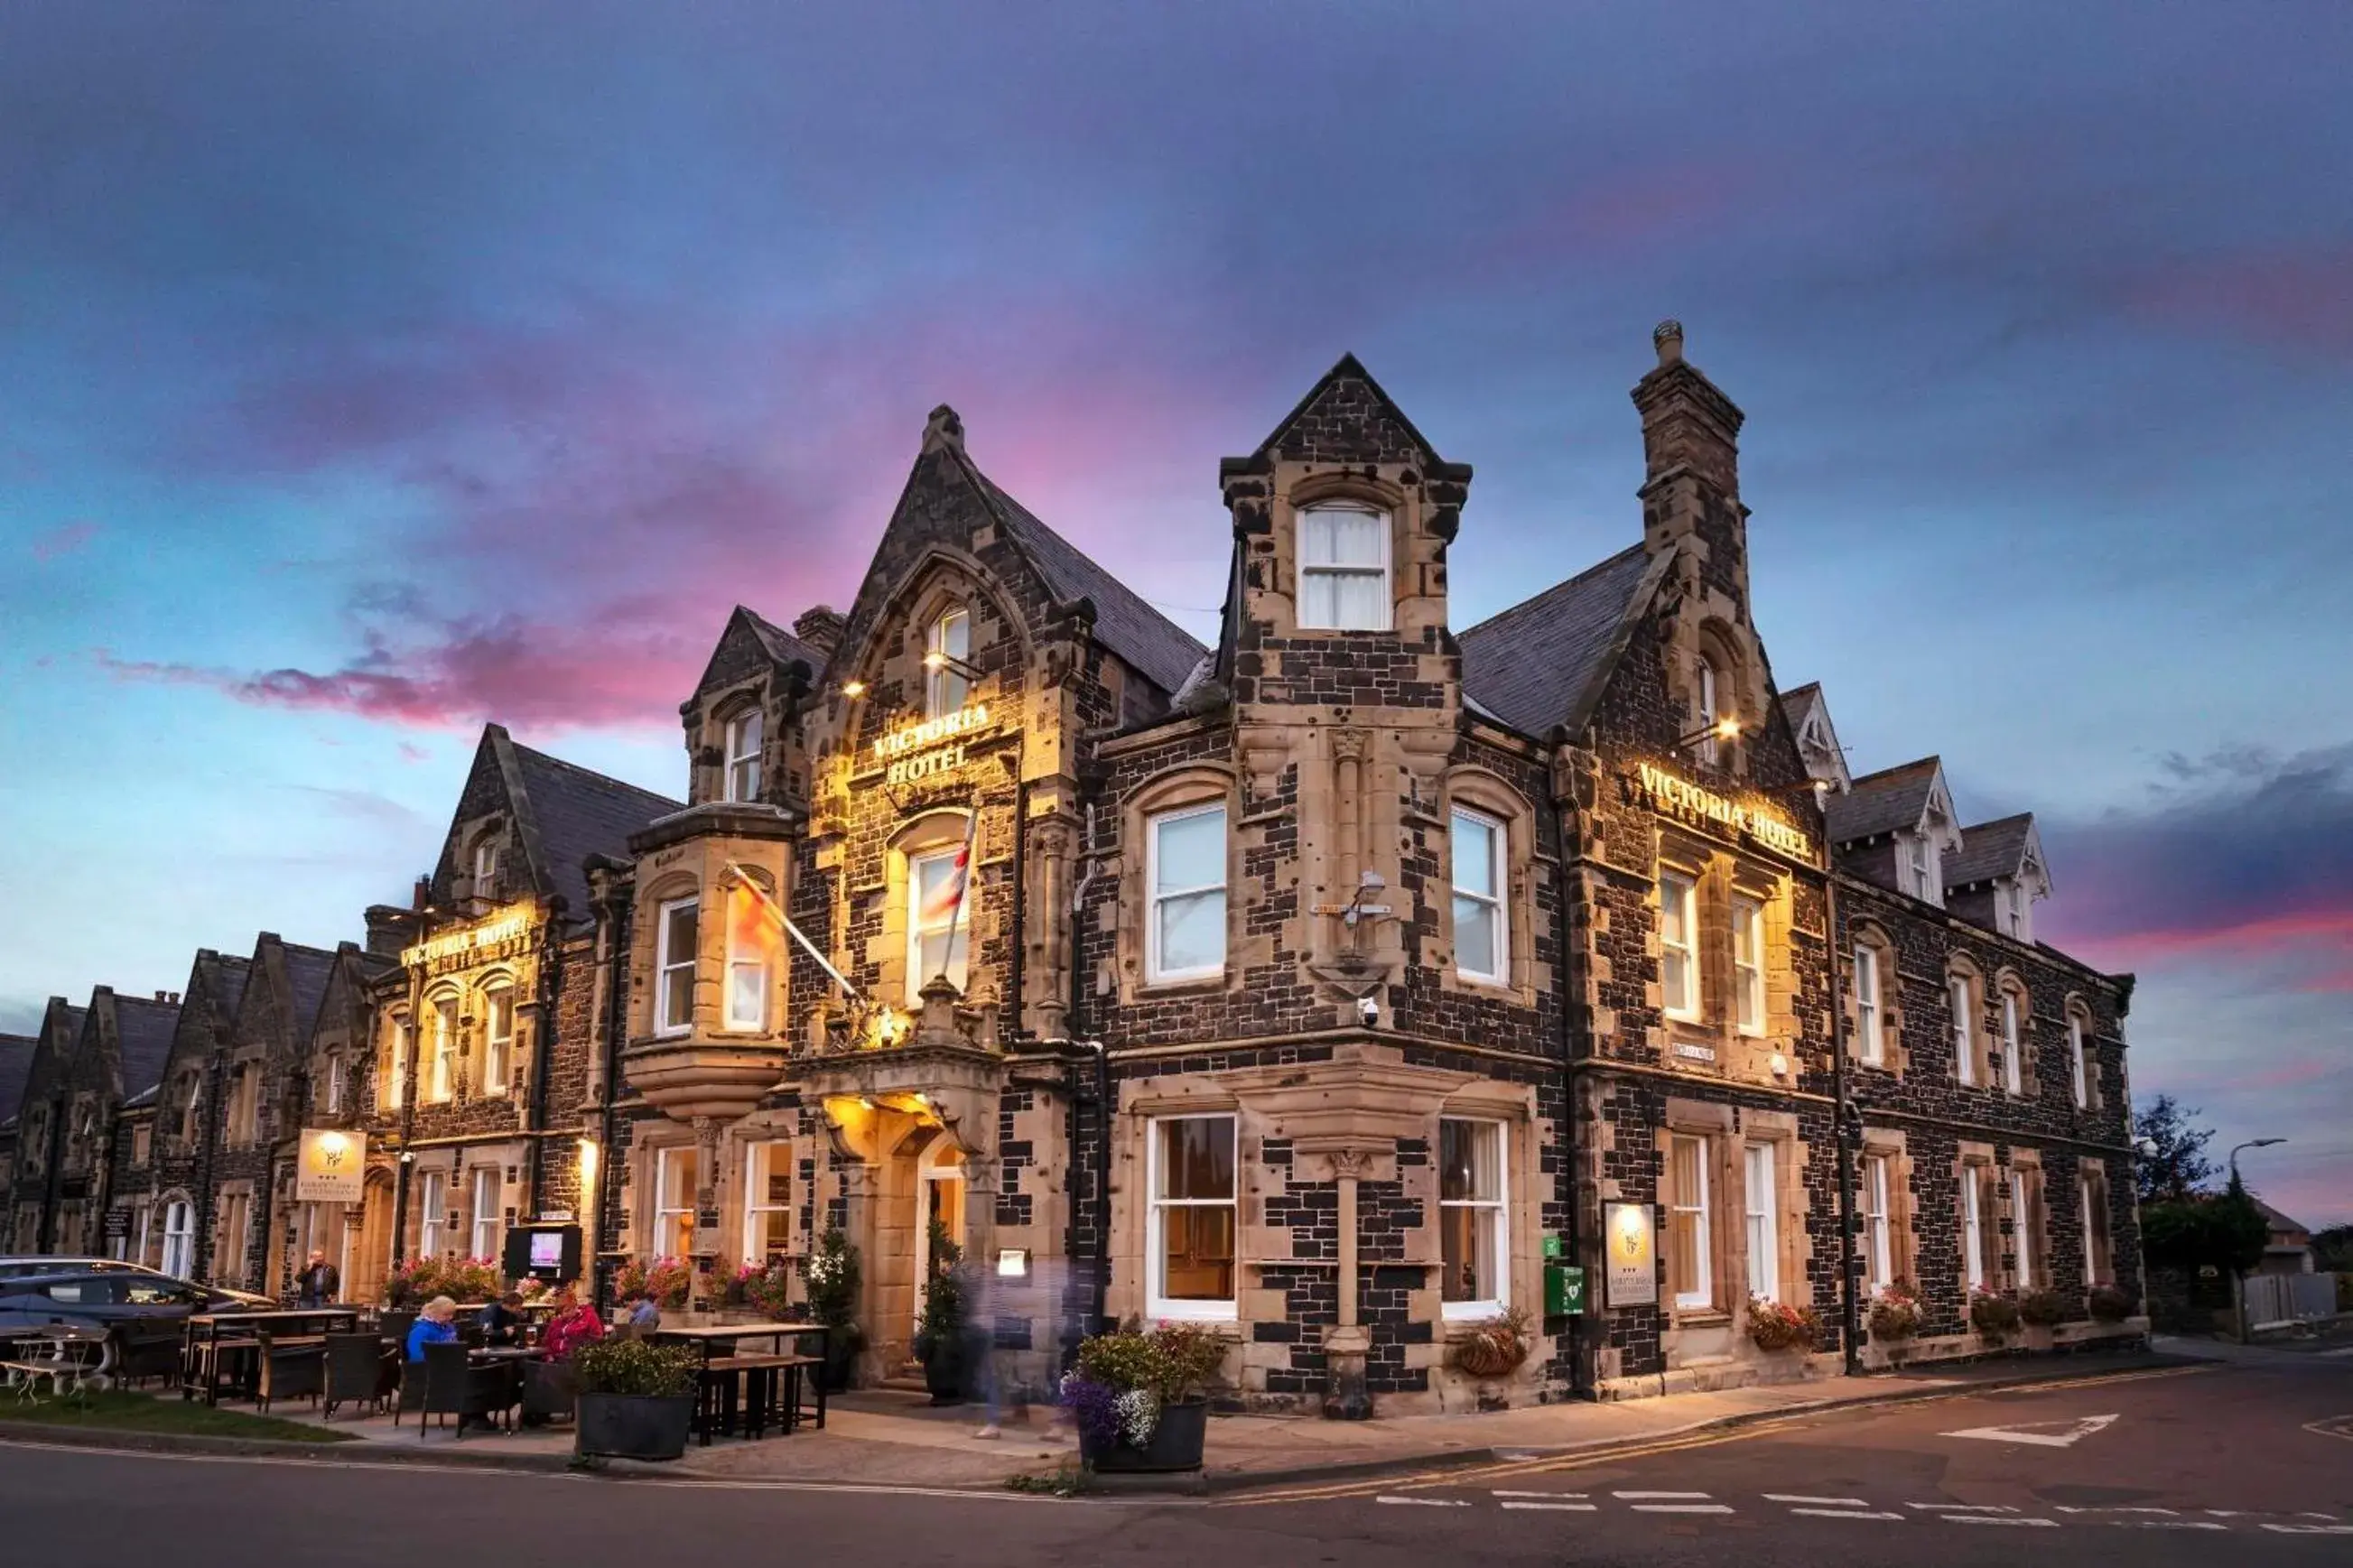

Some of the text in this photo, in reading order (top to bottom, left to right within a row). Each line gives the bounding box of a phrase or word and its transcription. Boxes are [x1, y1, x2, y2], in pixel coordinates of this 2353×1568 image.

[874, 704, 987, 757] VICTORIA
[887, 745, 969, 785] HOTEL
[1641, 763, 1811, 858] VICTORIA HOTEL
